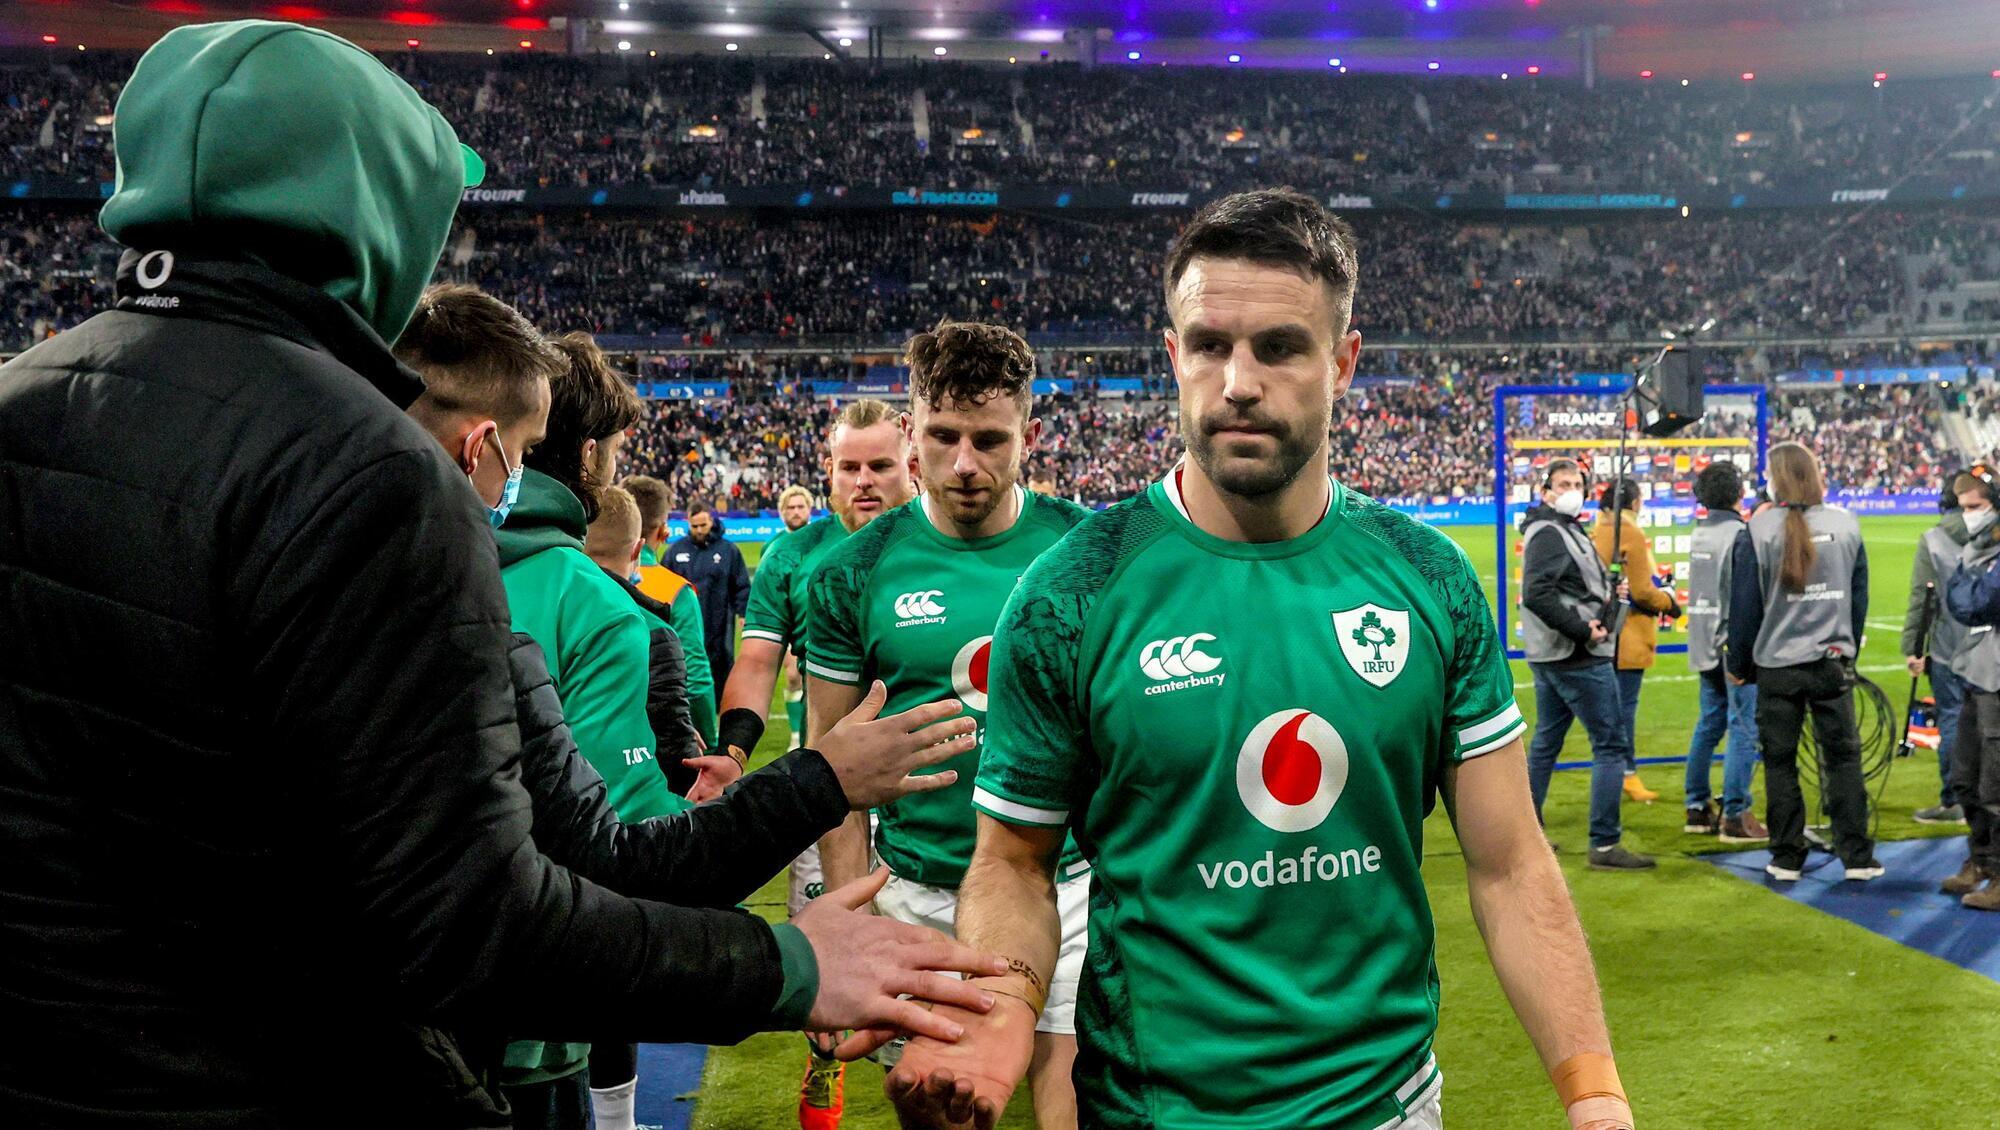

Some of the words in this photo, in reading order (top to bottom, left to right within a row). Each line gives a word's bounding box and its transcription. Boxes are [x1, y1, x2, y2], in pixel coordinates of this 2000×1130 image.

[135, 293, 180, 308] voone
[1548, 411, 1617, 426] FRANCE
[895, 615, 947, 628] canterbury
[1362, 660, 1396, 674] IRFU
[1144, 672, 1226, 696] canterbury
[1197, 845, 1382, 889] vodafone
